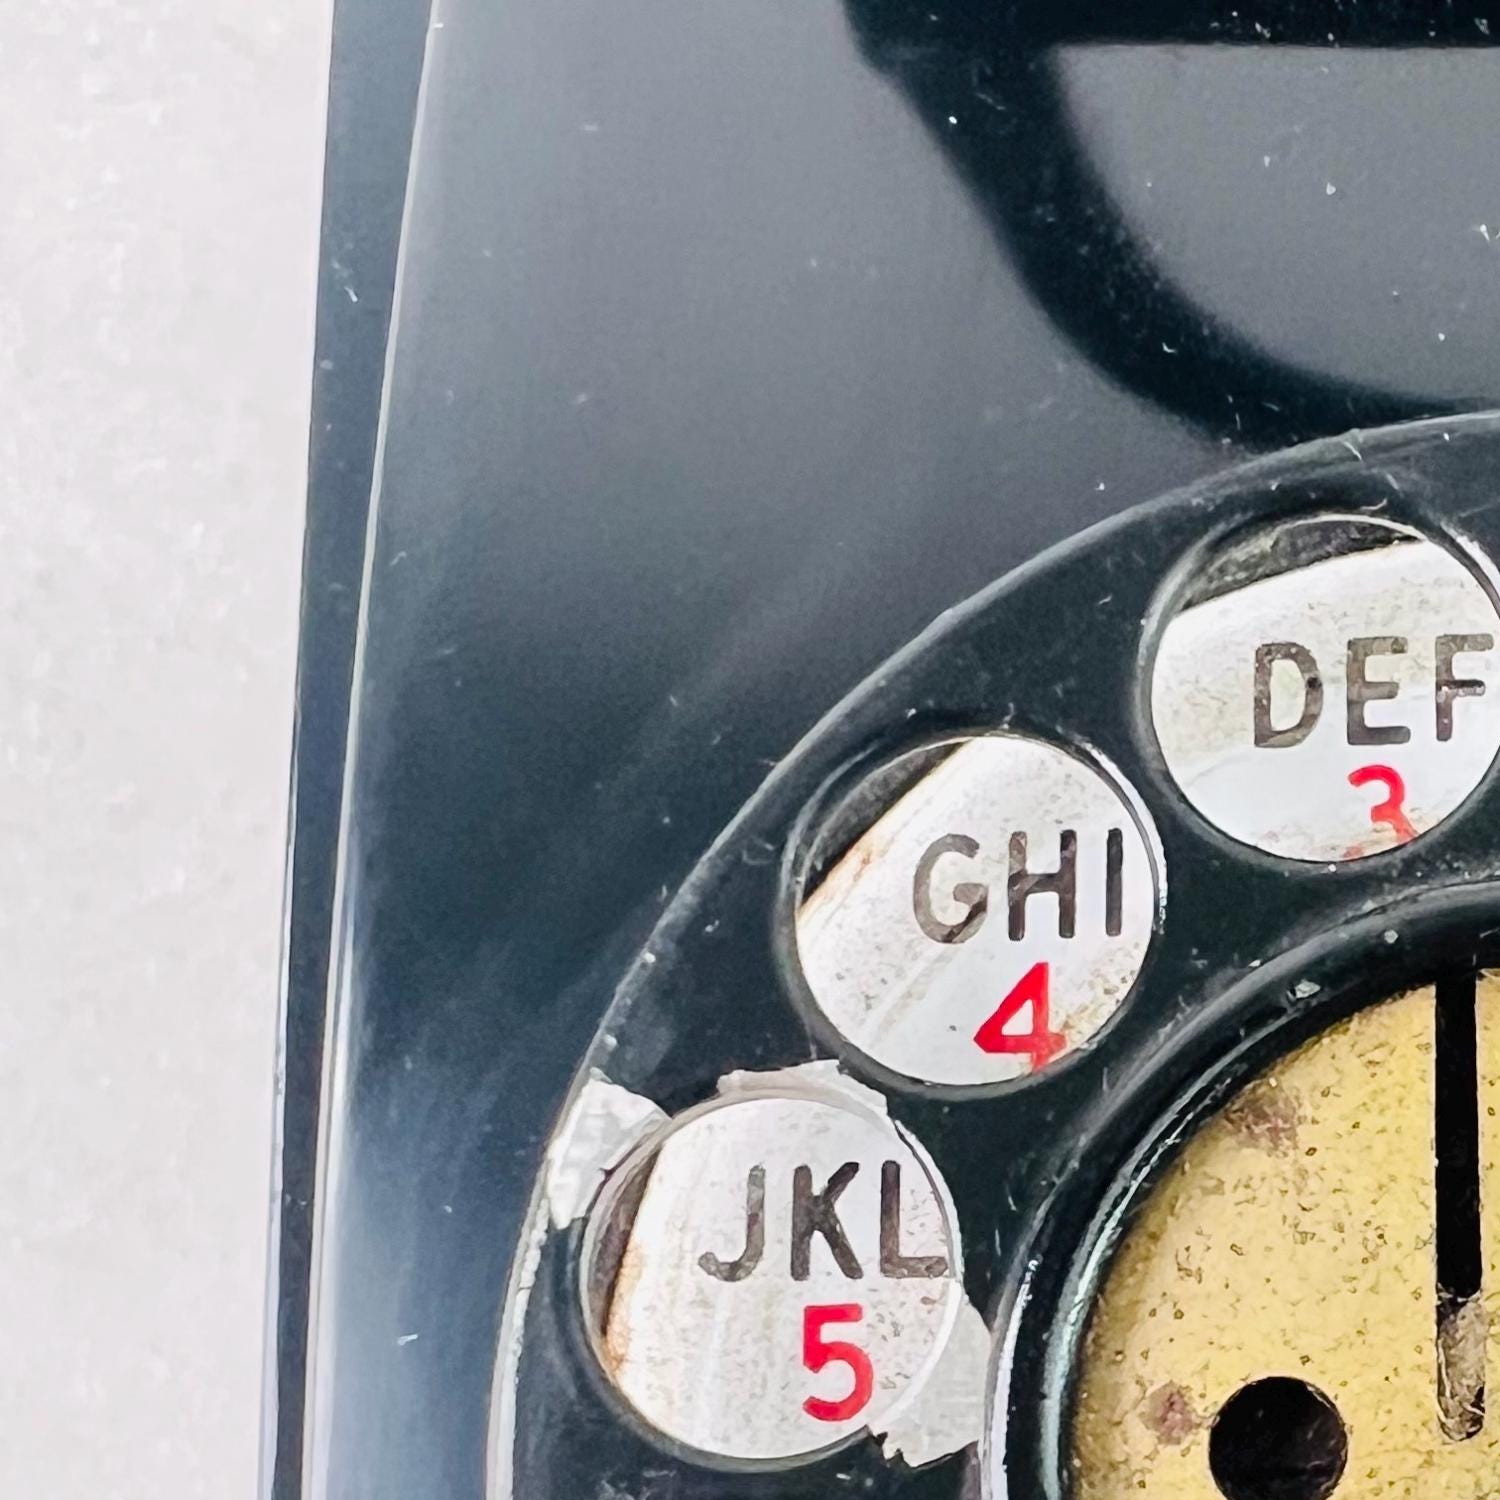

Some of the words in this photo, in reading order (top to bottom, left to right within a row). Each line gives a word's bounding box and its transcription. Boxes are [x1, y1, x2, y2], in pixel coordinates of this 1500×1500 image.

[1253, 635, 1493, 749] DEF
[1344, 763, 1415, 853] 3
[912, 826, 1124, 944] GHI
[973, 961, 1067, 1073] 4
[698, 1160, 948, 1283] JKL
[802, 1303, 874, 1423] 5
